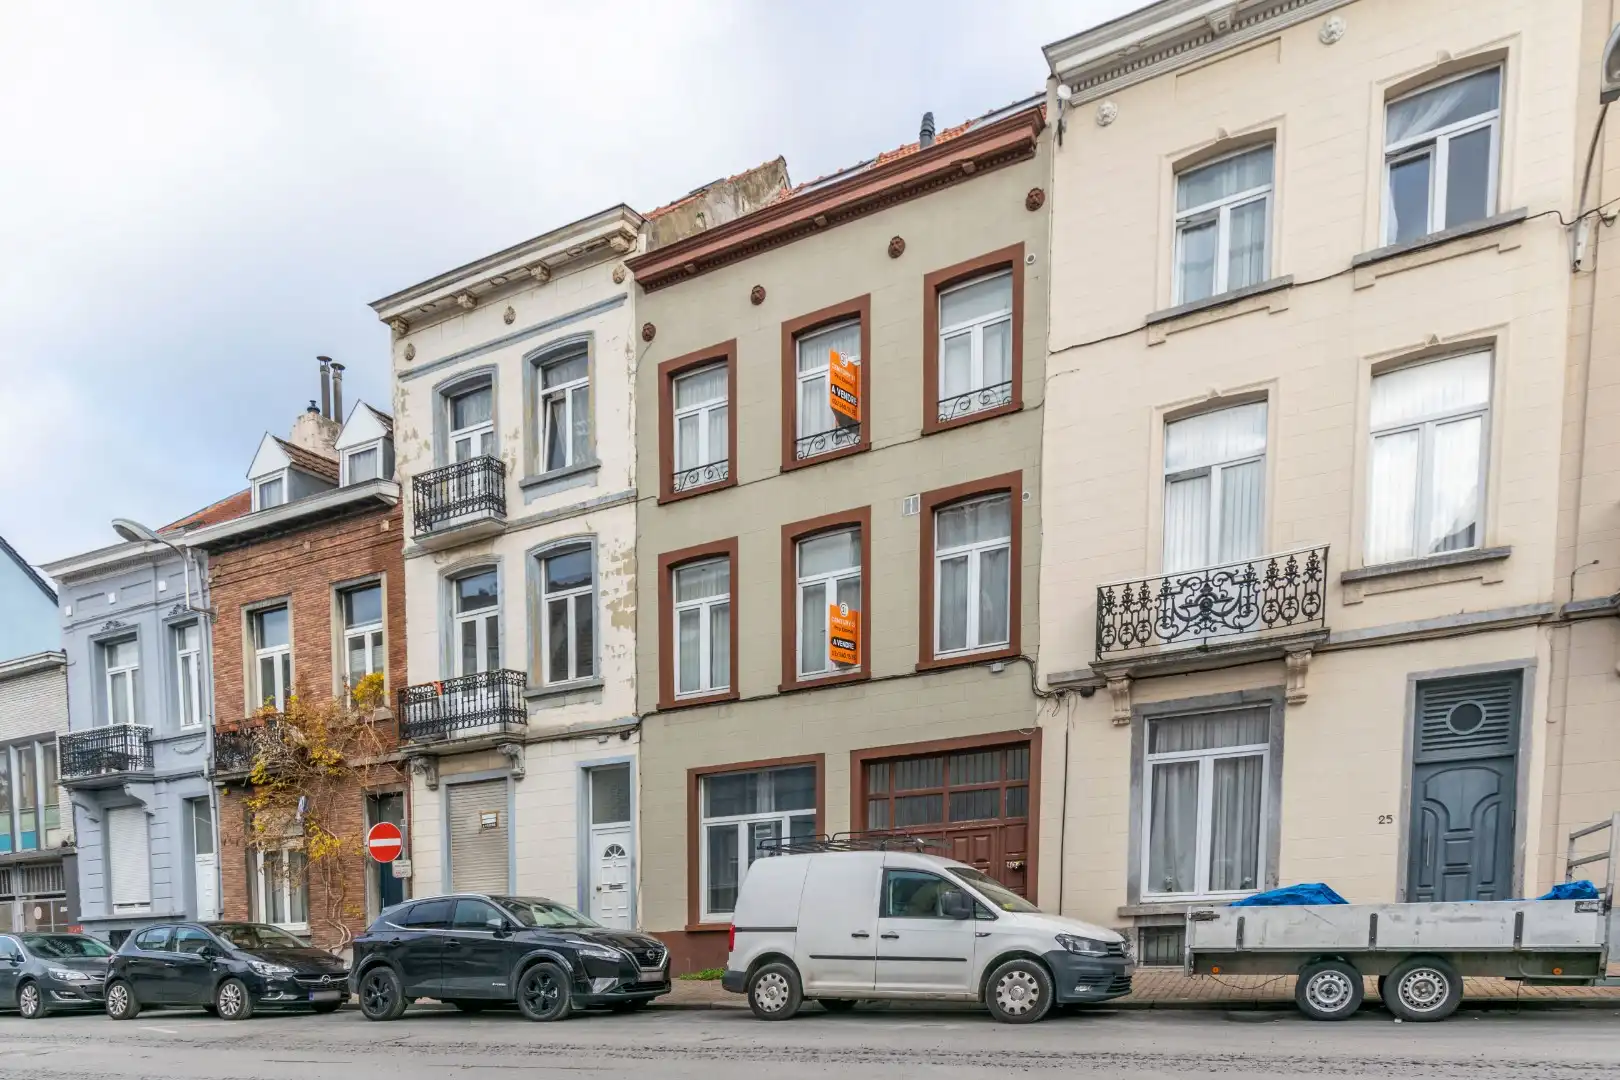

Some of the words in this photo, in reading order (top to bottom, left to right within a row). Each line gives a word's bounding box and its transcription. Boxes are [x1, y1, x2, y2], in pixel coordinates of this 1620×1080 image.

[831, 385, 836, 394] A
[837, 387, 857, 405] VENDRE
[832, 638, 837, 646] A
[837, 639, 855, 650] VENDRE
[1378, 814, 1393, 825] 25
